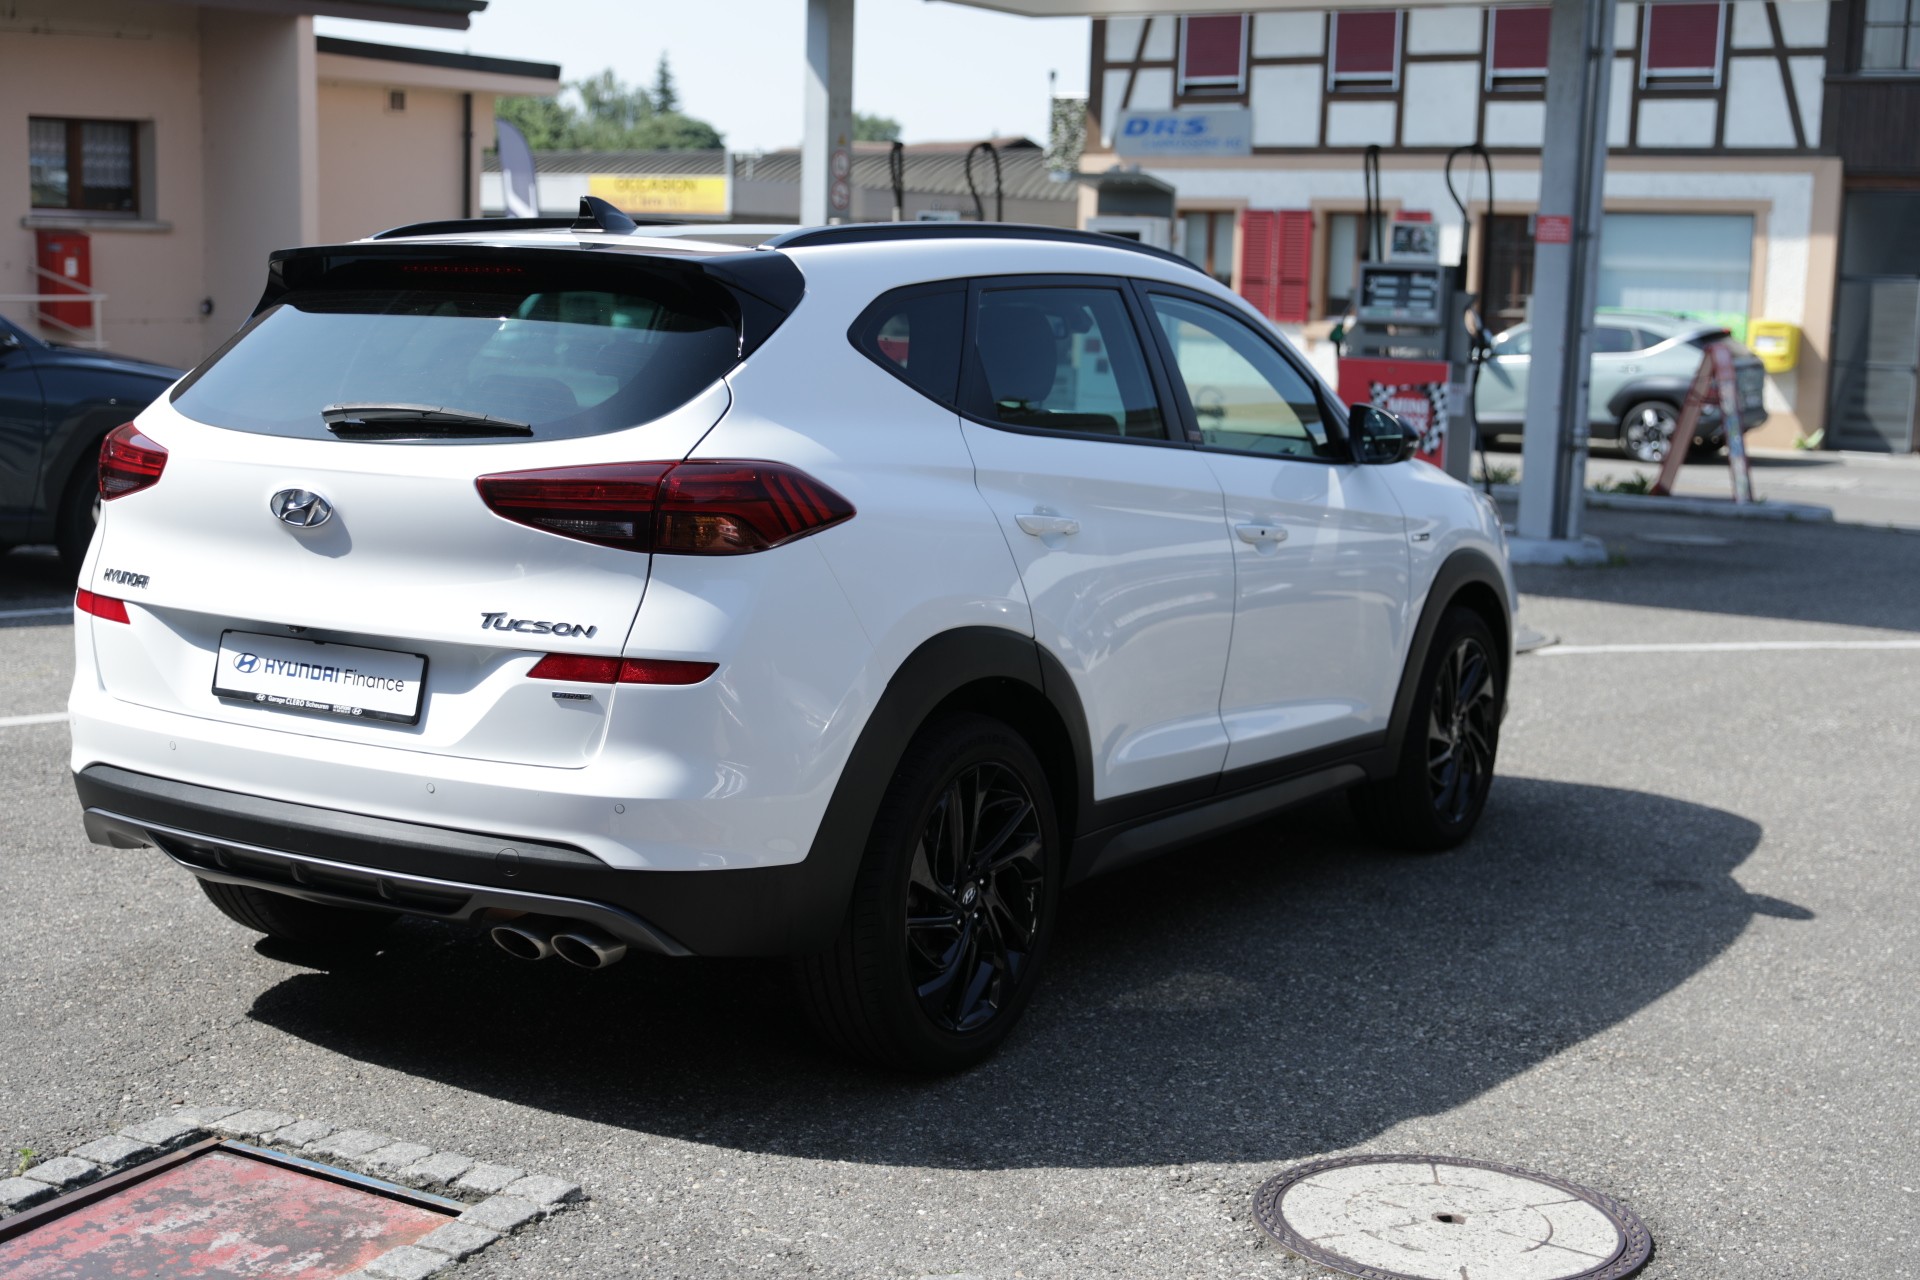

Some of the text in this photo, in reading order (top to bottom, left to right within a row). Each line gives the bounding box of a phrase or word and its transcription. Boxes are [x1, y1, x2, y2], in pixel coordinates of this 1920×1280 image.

[1124, 116, 1208, 136] DRS
[614, 177, 697, 193] OCCASION
[104, 568, 150, 589] HYUNDAI
[264, 658, 405, 693] HYUNDAI Finance
[268, 695, 285, 704] Garage
[305, 701, 330, 710] Scheuren
